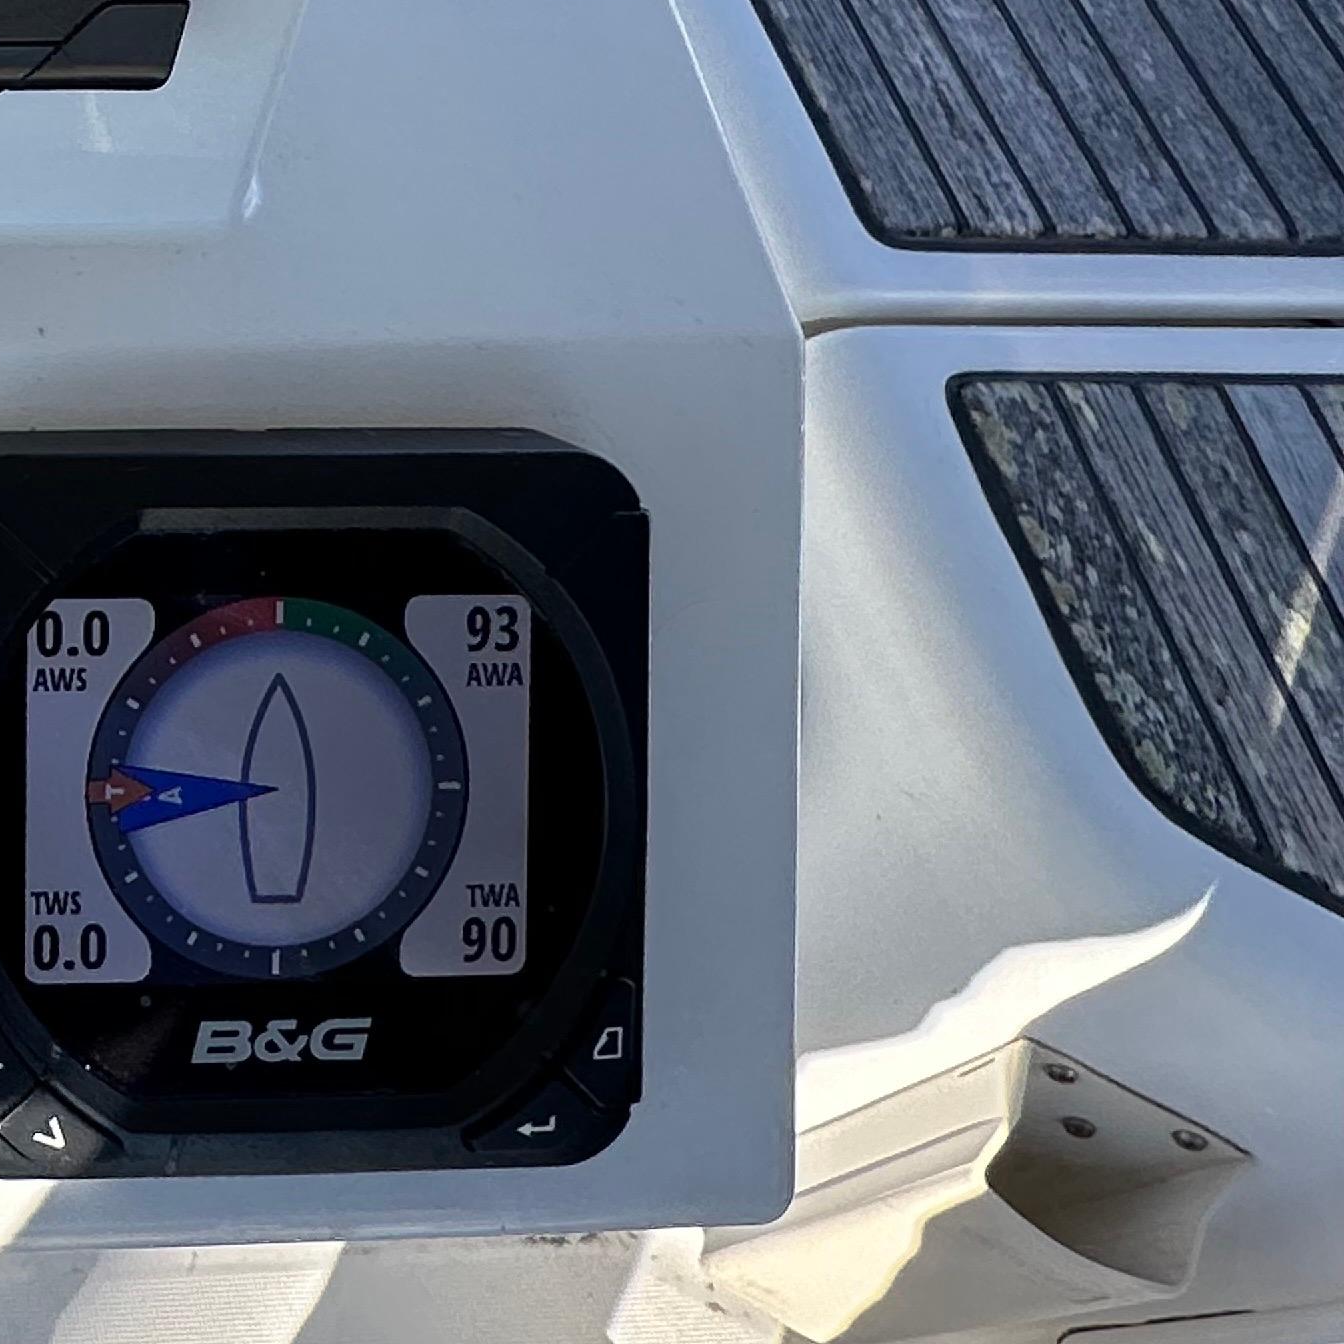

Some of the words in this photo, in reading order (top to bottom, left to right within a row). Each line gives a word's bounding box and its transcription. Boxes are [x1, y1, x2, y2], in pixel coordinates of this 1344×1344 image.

[34, 609, 112, 658] 0.0
[465, 605, 521, 653] 93
[32, 667, 88, 693] AWS
[465, 661, 524, 688] AWA
[30, 889, 83, 916] TWS
[465, 883, 521, 908] TWA
[31, 923, 108, 971] 0.0
[460, 915, 518, 963] 90
[190, 1016, 373, 1065] B&G
